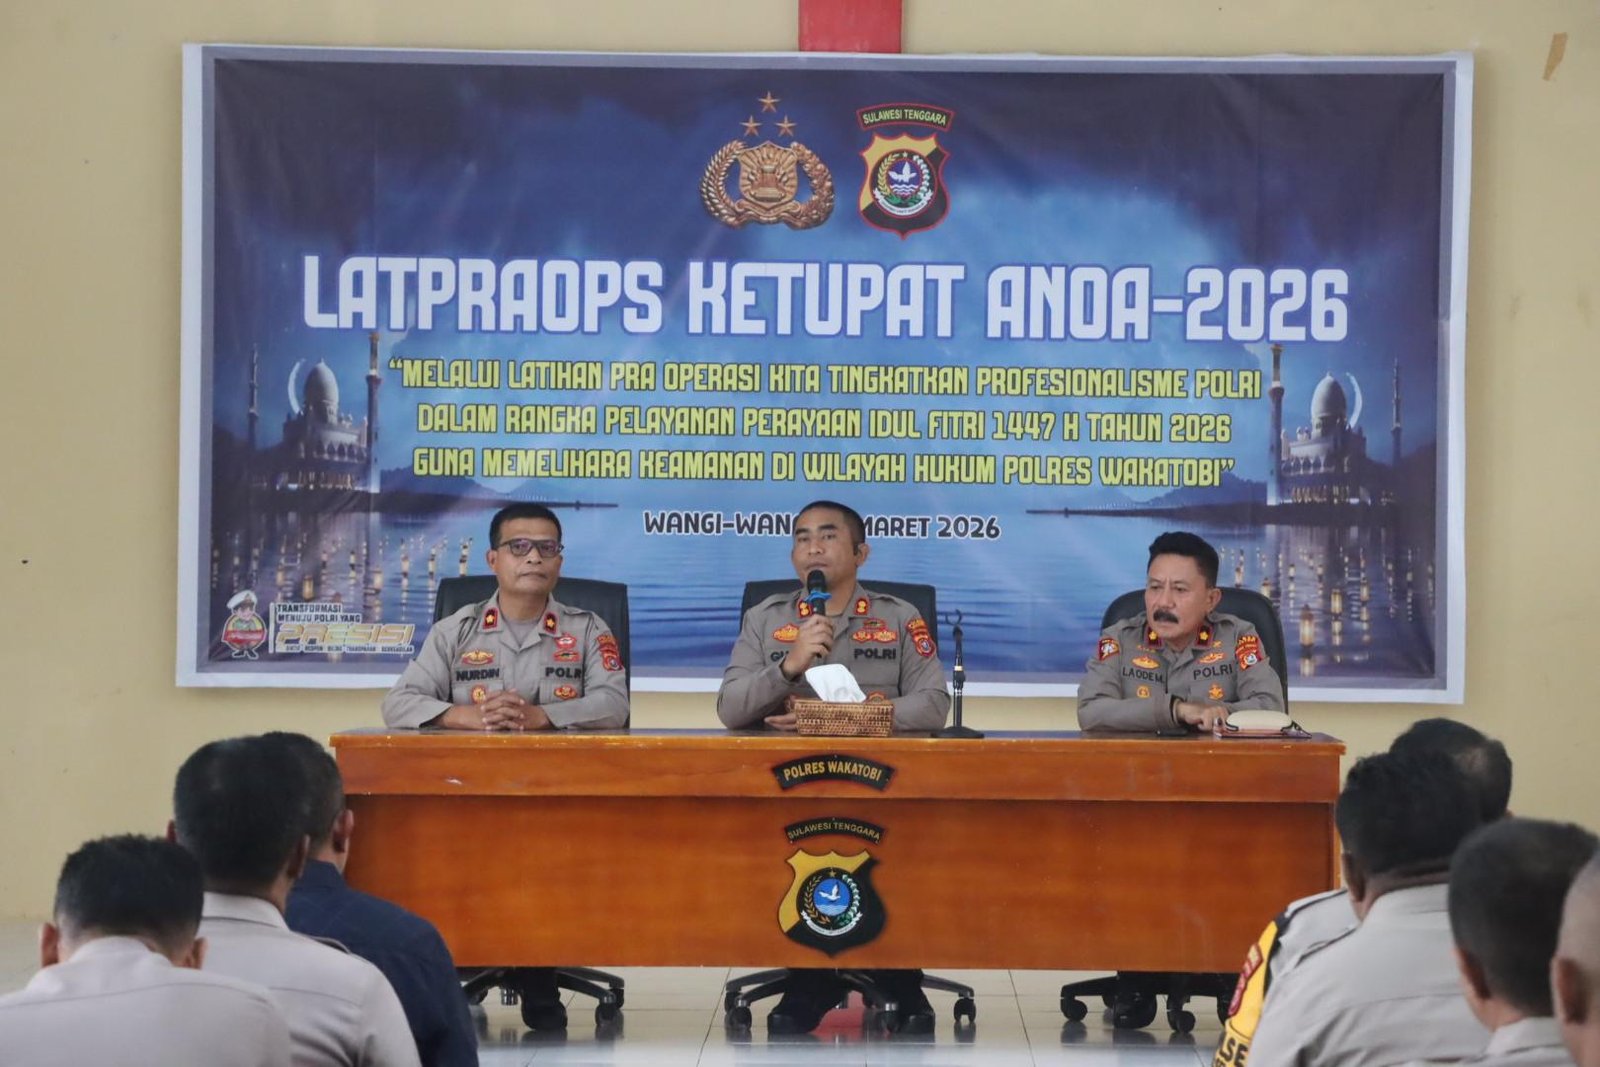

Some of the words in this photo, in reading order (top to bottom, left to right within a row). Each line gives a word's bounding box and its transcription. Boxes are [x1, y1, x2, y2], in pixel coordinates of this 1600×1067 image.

[863, 109, 902, 124] SULAWESI
[904, 109, 947, 125] TENGGARA
[304, 255, 663, 333] LATPRAOPS
[688, 261, 965, 337] KETUPAT
[987, 265, 1348, 341] ANOA-2026
[509, 361, 602, 389] LATIHAN
[611, 363, 655, 390] PRA
[664, 363, 761, 392] OPERASI
[769, 364, 820, 392] KITA
[828, 365, 968, 395] TINGKATKAN
[976, 367, 1187, 398] PROFESIONALISME
[1195, 370, 1261, 398] POLRI
[418, 404, 497, 432] DALAM
[505, 405, 597, 433] RANGKA
[605, 406, 735, 435] PELAYANAN
[743, 407, 861, 437] PERAYAAN
[869, 410, 921, 438] IDUL
[928, 410, 985, 439] FITRI
[993, 412, 1056, 440] 1447
[1063, 413, 1079, 440] H
[1086, 413, 1162, 442] TAHUN
[1171, 414, 1231, 442] 2026
[414, 447, 474, 476] GUNA
[483, 449, 631, 478] MEMELIHARA
[639, 451, 764, 480] KEAMANAN
[772, 452, 795, 480] DI
[803, 453, 906, 482] WILAYAH
[915, 455, 995, 483] HUKUM
[1004, 456, 1091, 485] POLRES
[938, 516, 1000, 539] 2026
[277, 604, 341, 613] TRANSFORMASI
[278, 614, 312, 622] MENUJU
[314, 614, 338, 622] POLRI
[340, 614, 361, 622] YANG
[854, 648, 896, 660] POLRI
[456, 668, 500, 681] NURDIN
[1193, 663, 1233, 680] POLRI
[783, 761, 825, 781] POLRES
[827, 761, 883, 781] WAKATOBI
[788, 822, 832, 839] SULAWESI
[834, 822, 880, 840] TENGGARA
